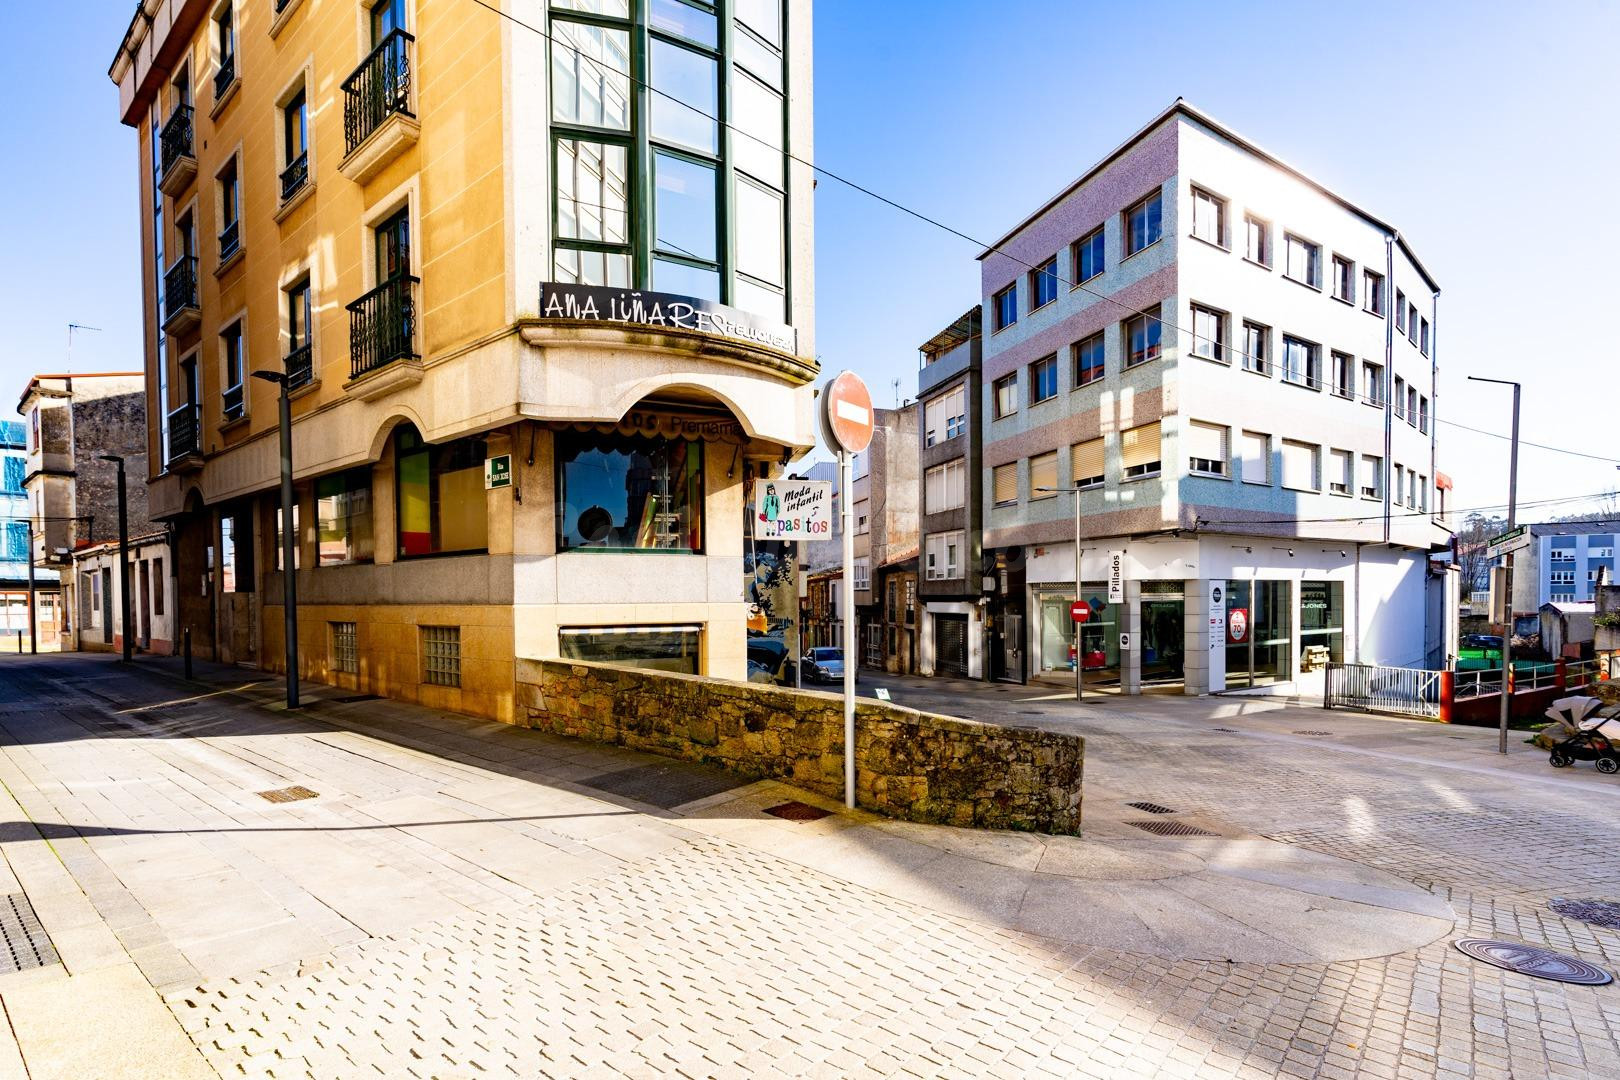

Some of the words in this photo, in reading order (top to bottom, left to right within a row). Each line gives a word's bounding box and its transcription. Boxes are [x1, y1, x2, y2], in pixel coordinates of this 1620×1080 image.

[545, 292, 600, 321] ANA
[784, 485, 811, 502] Moda
[787, 489, 823, 512] infantil
[776, 515, 828, 536] pasitos
[1112, 555, 1120, 592] Pillados
